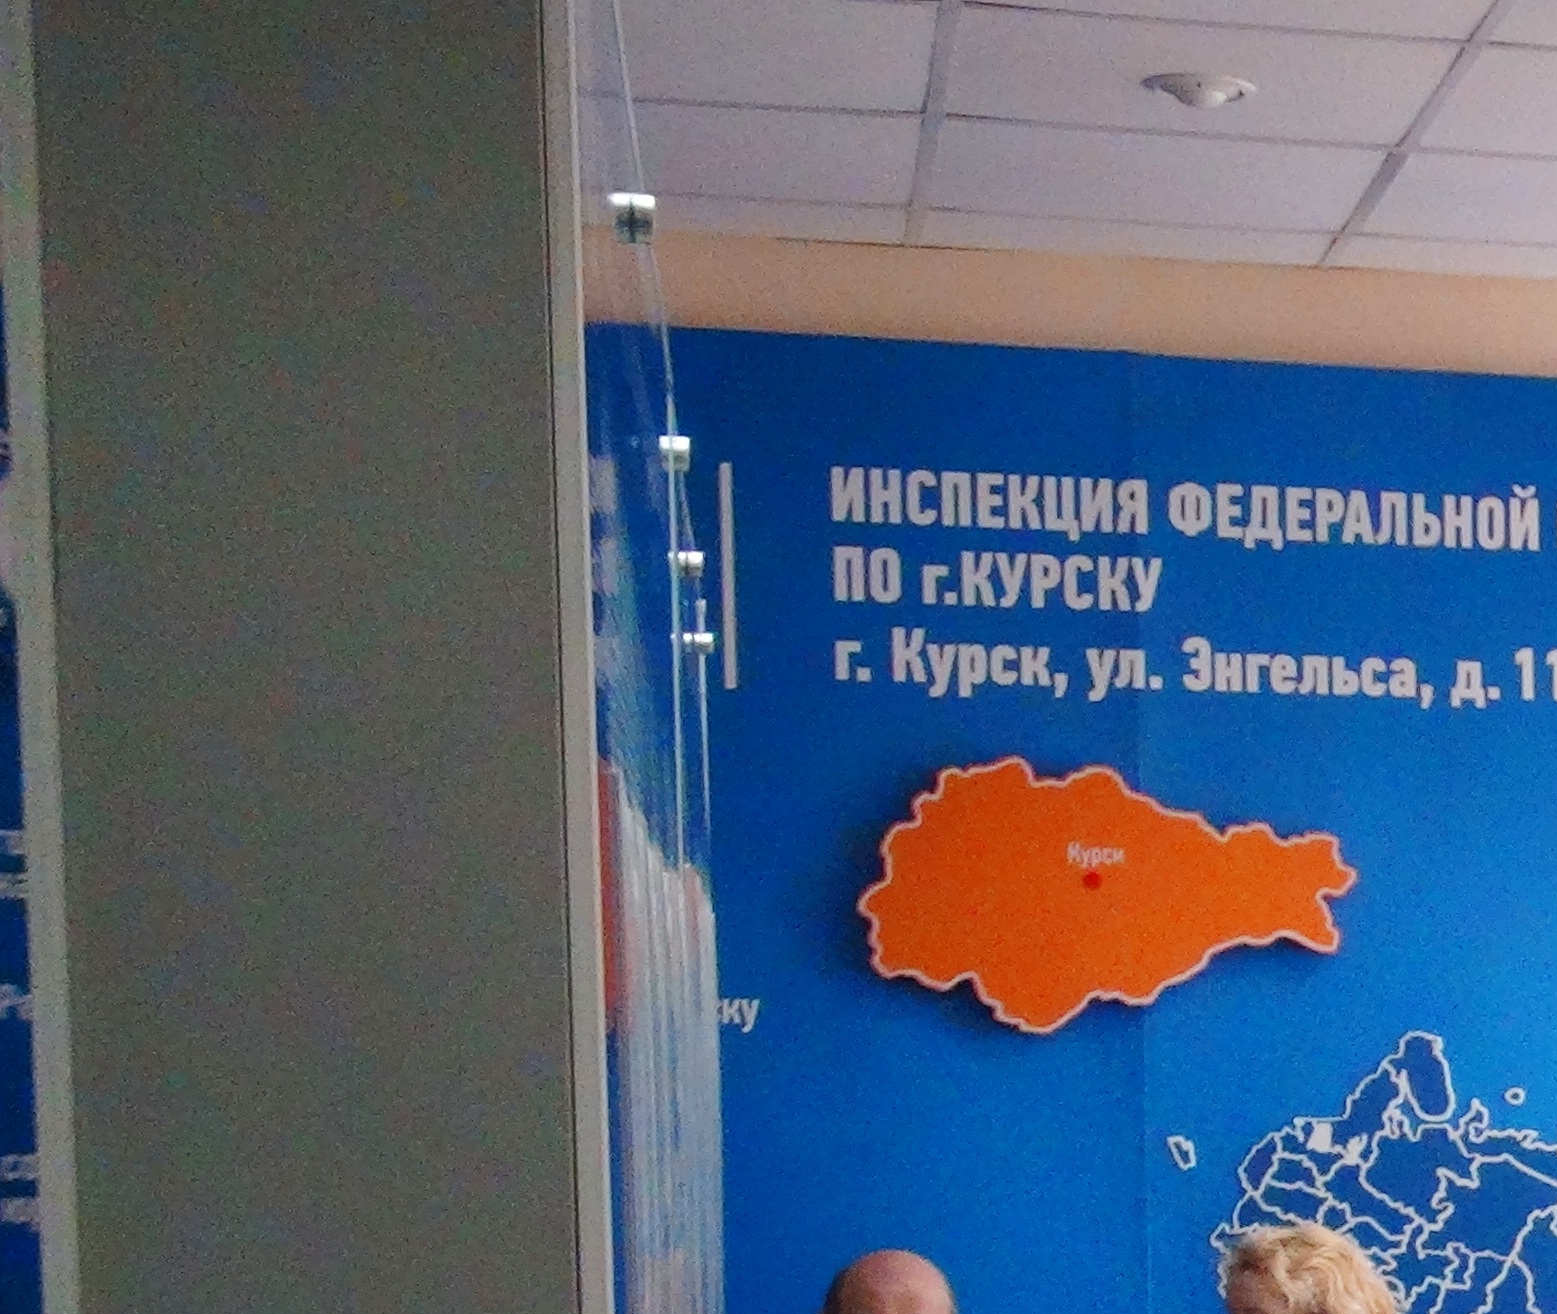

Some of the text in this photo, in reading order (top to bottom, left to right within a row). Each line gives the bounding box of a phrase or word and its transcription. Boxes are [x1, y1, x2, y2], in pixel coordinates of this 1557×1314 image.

[829, 465, 1149, 542] ИНСПЕКЦИЯ
[1168, 482, 1541, 553] ФЕДЕРАЛЬНОЙ
[832, 545, 1164, 613] ПО г.КУРСКУ
[833, 639, 872, 682] г.
[890, 626, 1069, 698] Курск,
[1084, 646, 1164, 703] ул.
[1181, 635, 1435, 710] Энгельса,
[1449, 659, 1501, 709] д.
[1066, 841, 1125, 867] Курск
[718, 998, 760, 1033] ку
